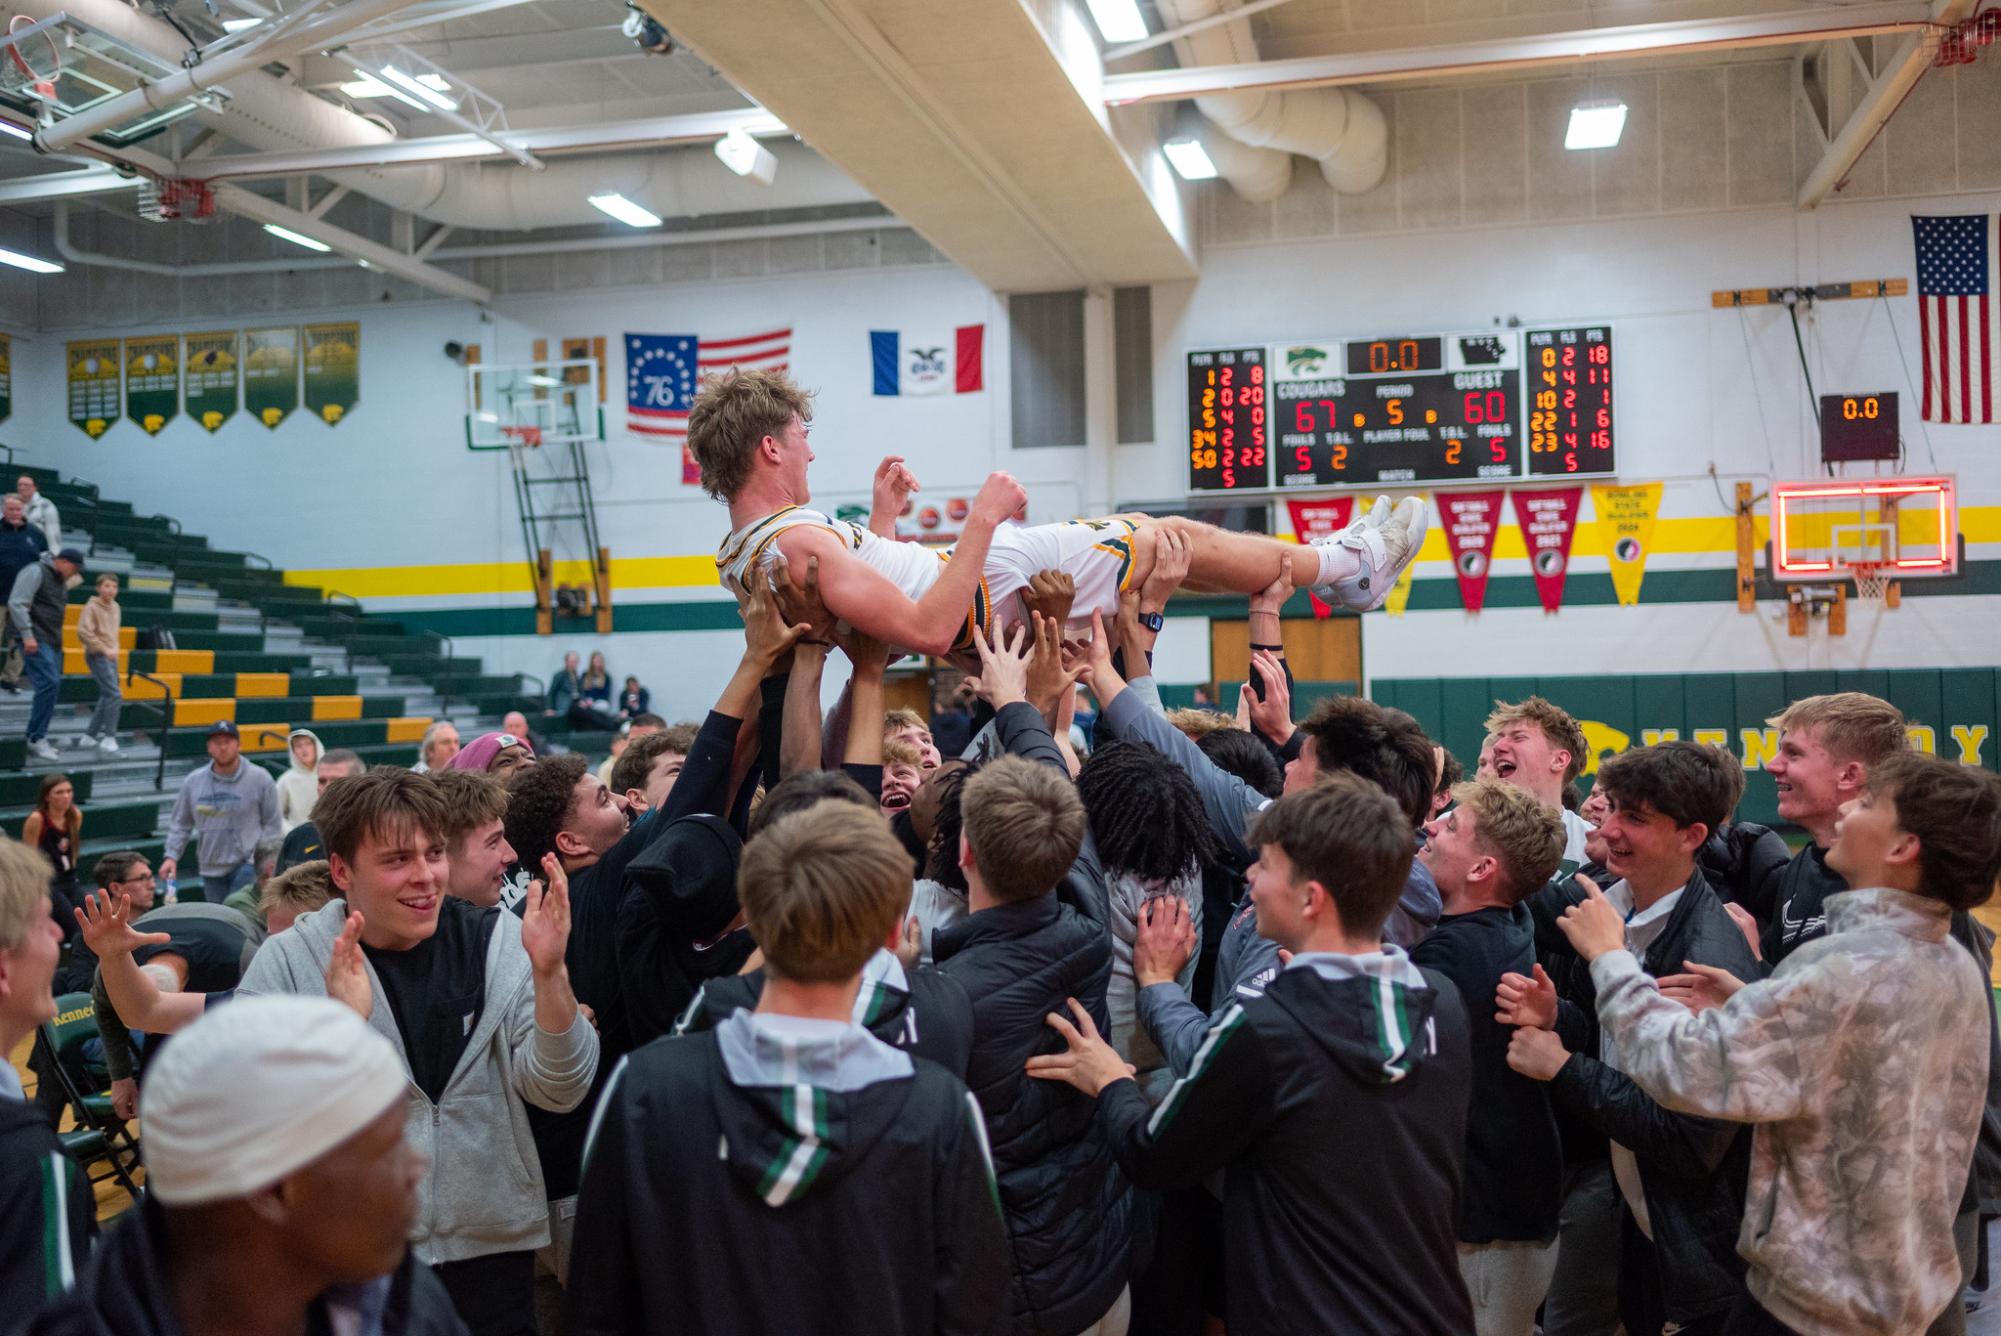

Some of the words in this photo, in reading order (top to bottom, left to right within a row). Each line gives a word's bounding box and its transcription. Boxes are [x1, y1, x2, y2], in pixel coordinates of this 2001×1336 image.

[1370, 341, 1418, 372] 0.0
[1542, 347, 1557, 368] 0
[1562, 346, 1576, 366] 2
[1588, 345, 1609, 365] 18
[1207, 368, 1216, 386] 1
[1220, 367, 1233, 386] 2
[1250, 365, 1264, 385] 8
[1454, 372, 1504, 390] GUEST
[1542, 369, 1557, 387] 4
[1562, 368, 1577, 386] 4
[643, 375, 675, 406] 76
[1202, 387, 1216, 408] 2
[1220, 387, 1234, 407] 0
[1239, 386, 1264, 406] 20
[1277, 381, 1346, 400] COUGARS
[1376, 384, 1414, 398] PERIOD
[1536, 390, 1557, 410] 10
[1563, 389, 1577, 409] 2
[1603, 389, 1610, 405] 1
[1202, 408, 1216, 429] 5
[1220, 409, 1234, 426] 4
[1251, 406, 1265, 425] 0
[1295, 400, 1337, 433] 67
[1386, 399, 1405, 425] 5
[1463, 391, 1506, 424] 60
[1843, 397, 1879, 420] 0.0
[1477, 423, 1512, 438] FOULS
[1530, 411, 1558, 432] 22
[1570, 411, 1577, 428] 1
[1597, 408, 1610, 428] 6
[1192, 429, 1216, 449] 34
[1221, 427, 1234, 447] 2
[1252, 426, 1265, 446] 5
[1282, 433, 1316, 447] FOULS
[1363, 429, 1402, 444] PLAYER
[1403, 427, 1431, 442] FOUL
[1531, 432, 1558, 453] 23
[1564, 432, 1577, 449] 4
[1591, 430, 1610, 450] 16
[1222, 448, 1235, 468] 2
[1240, 447, 1265, 467] 22
[1295, 446, 1313, 472] 5
[1331, 444, 1348, 470] 2
[1445, 438, 1462, 465] 2
[1489, 436, 1508, 463] 5
[1477, 465, 1512, 478] SCORE
[1564, 451, 1578, 472] 5
[1222, 468, 1235, 488] 5
